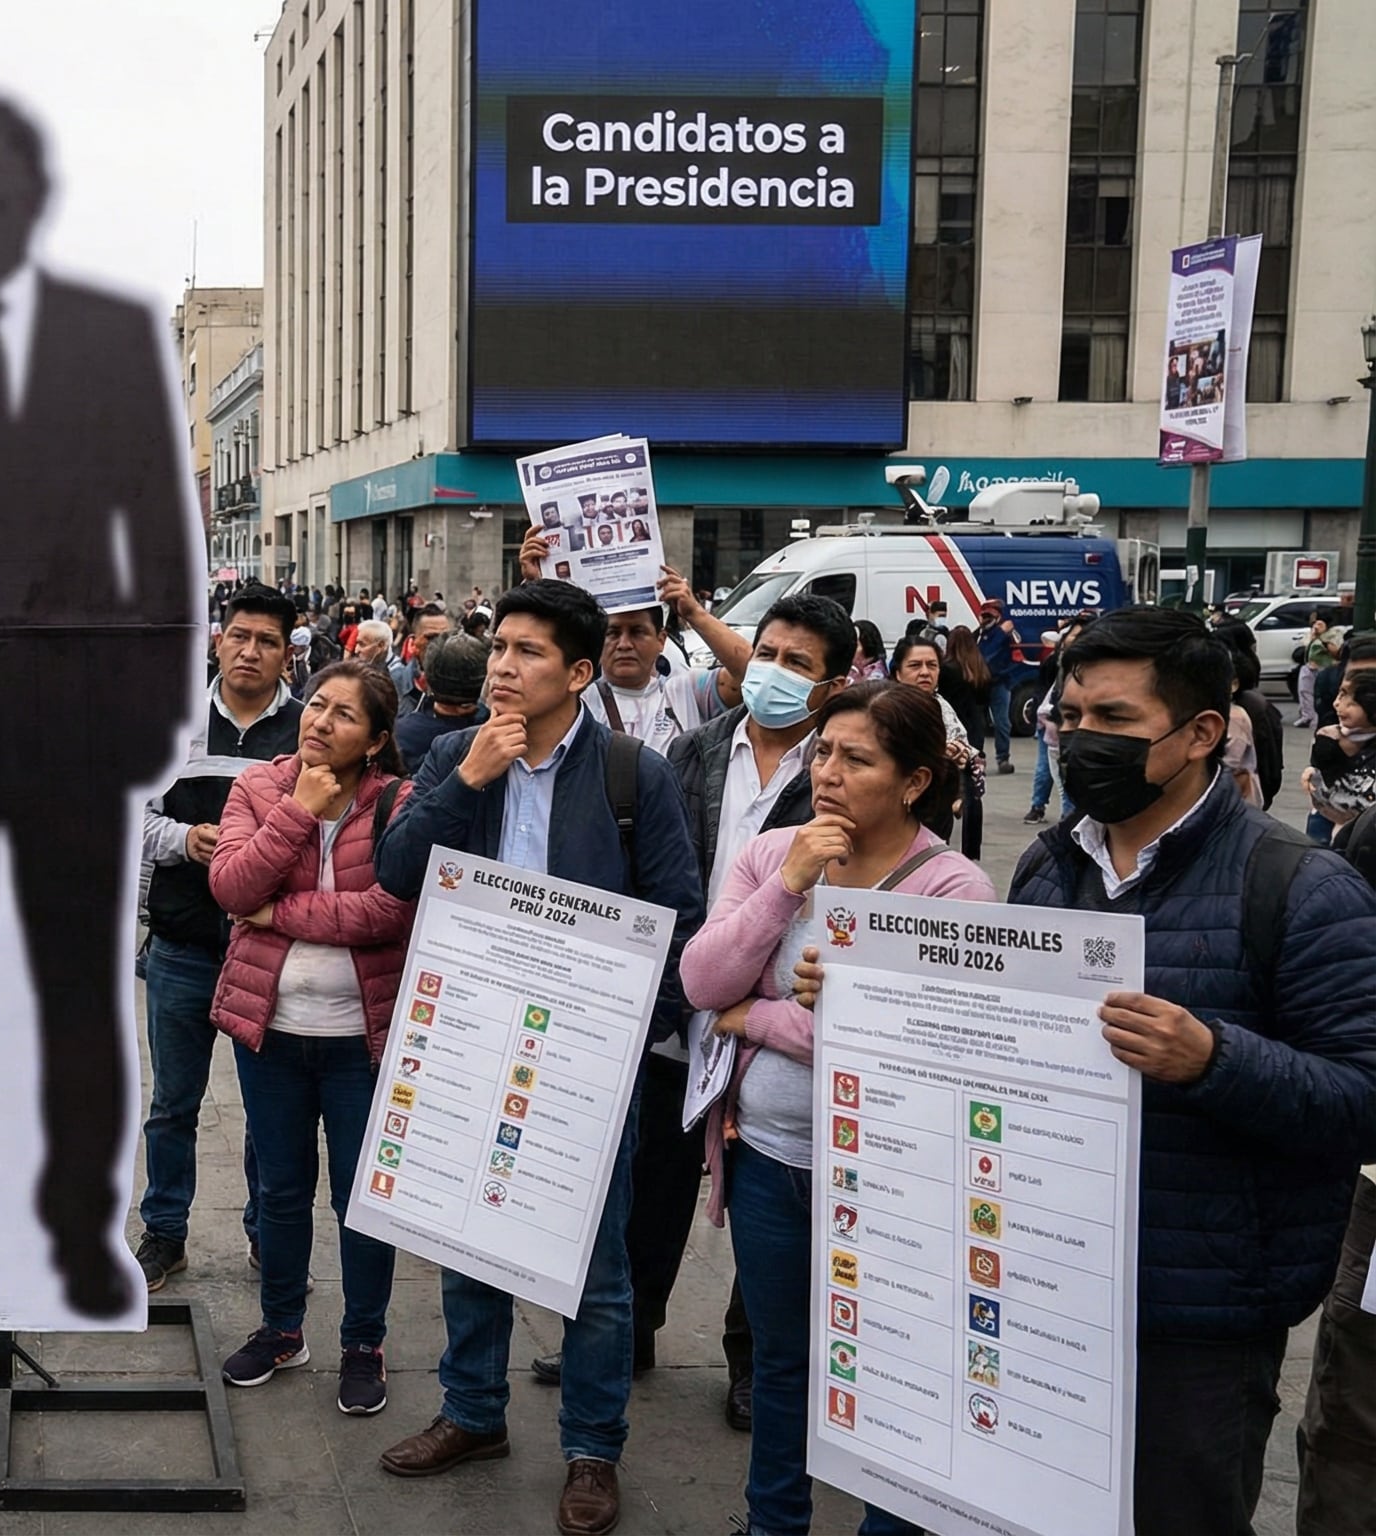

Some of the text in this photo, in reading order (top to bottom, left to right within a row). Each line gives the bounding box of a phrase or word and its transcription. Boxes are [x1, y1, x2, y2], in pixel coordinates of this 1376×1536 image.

[542, 110, 845, 154] Candidatos a
[532, 165, 855, 208] la Presidencia
[1006, 580, 1101, 605] NEWS
[473, 870, 622, 922] ELECCIONES GENERALES
[544, 907, 577, 927] 2026
[869, 912, 1063, 953] ELECCIONES GENERALES
[919, 942, 1005, 972] PERÚ 2026
